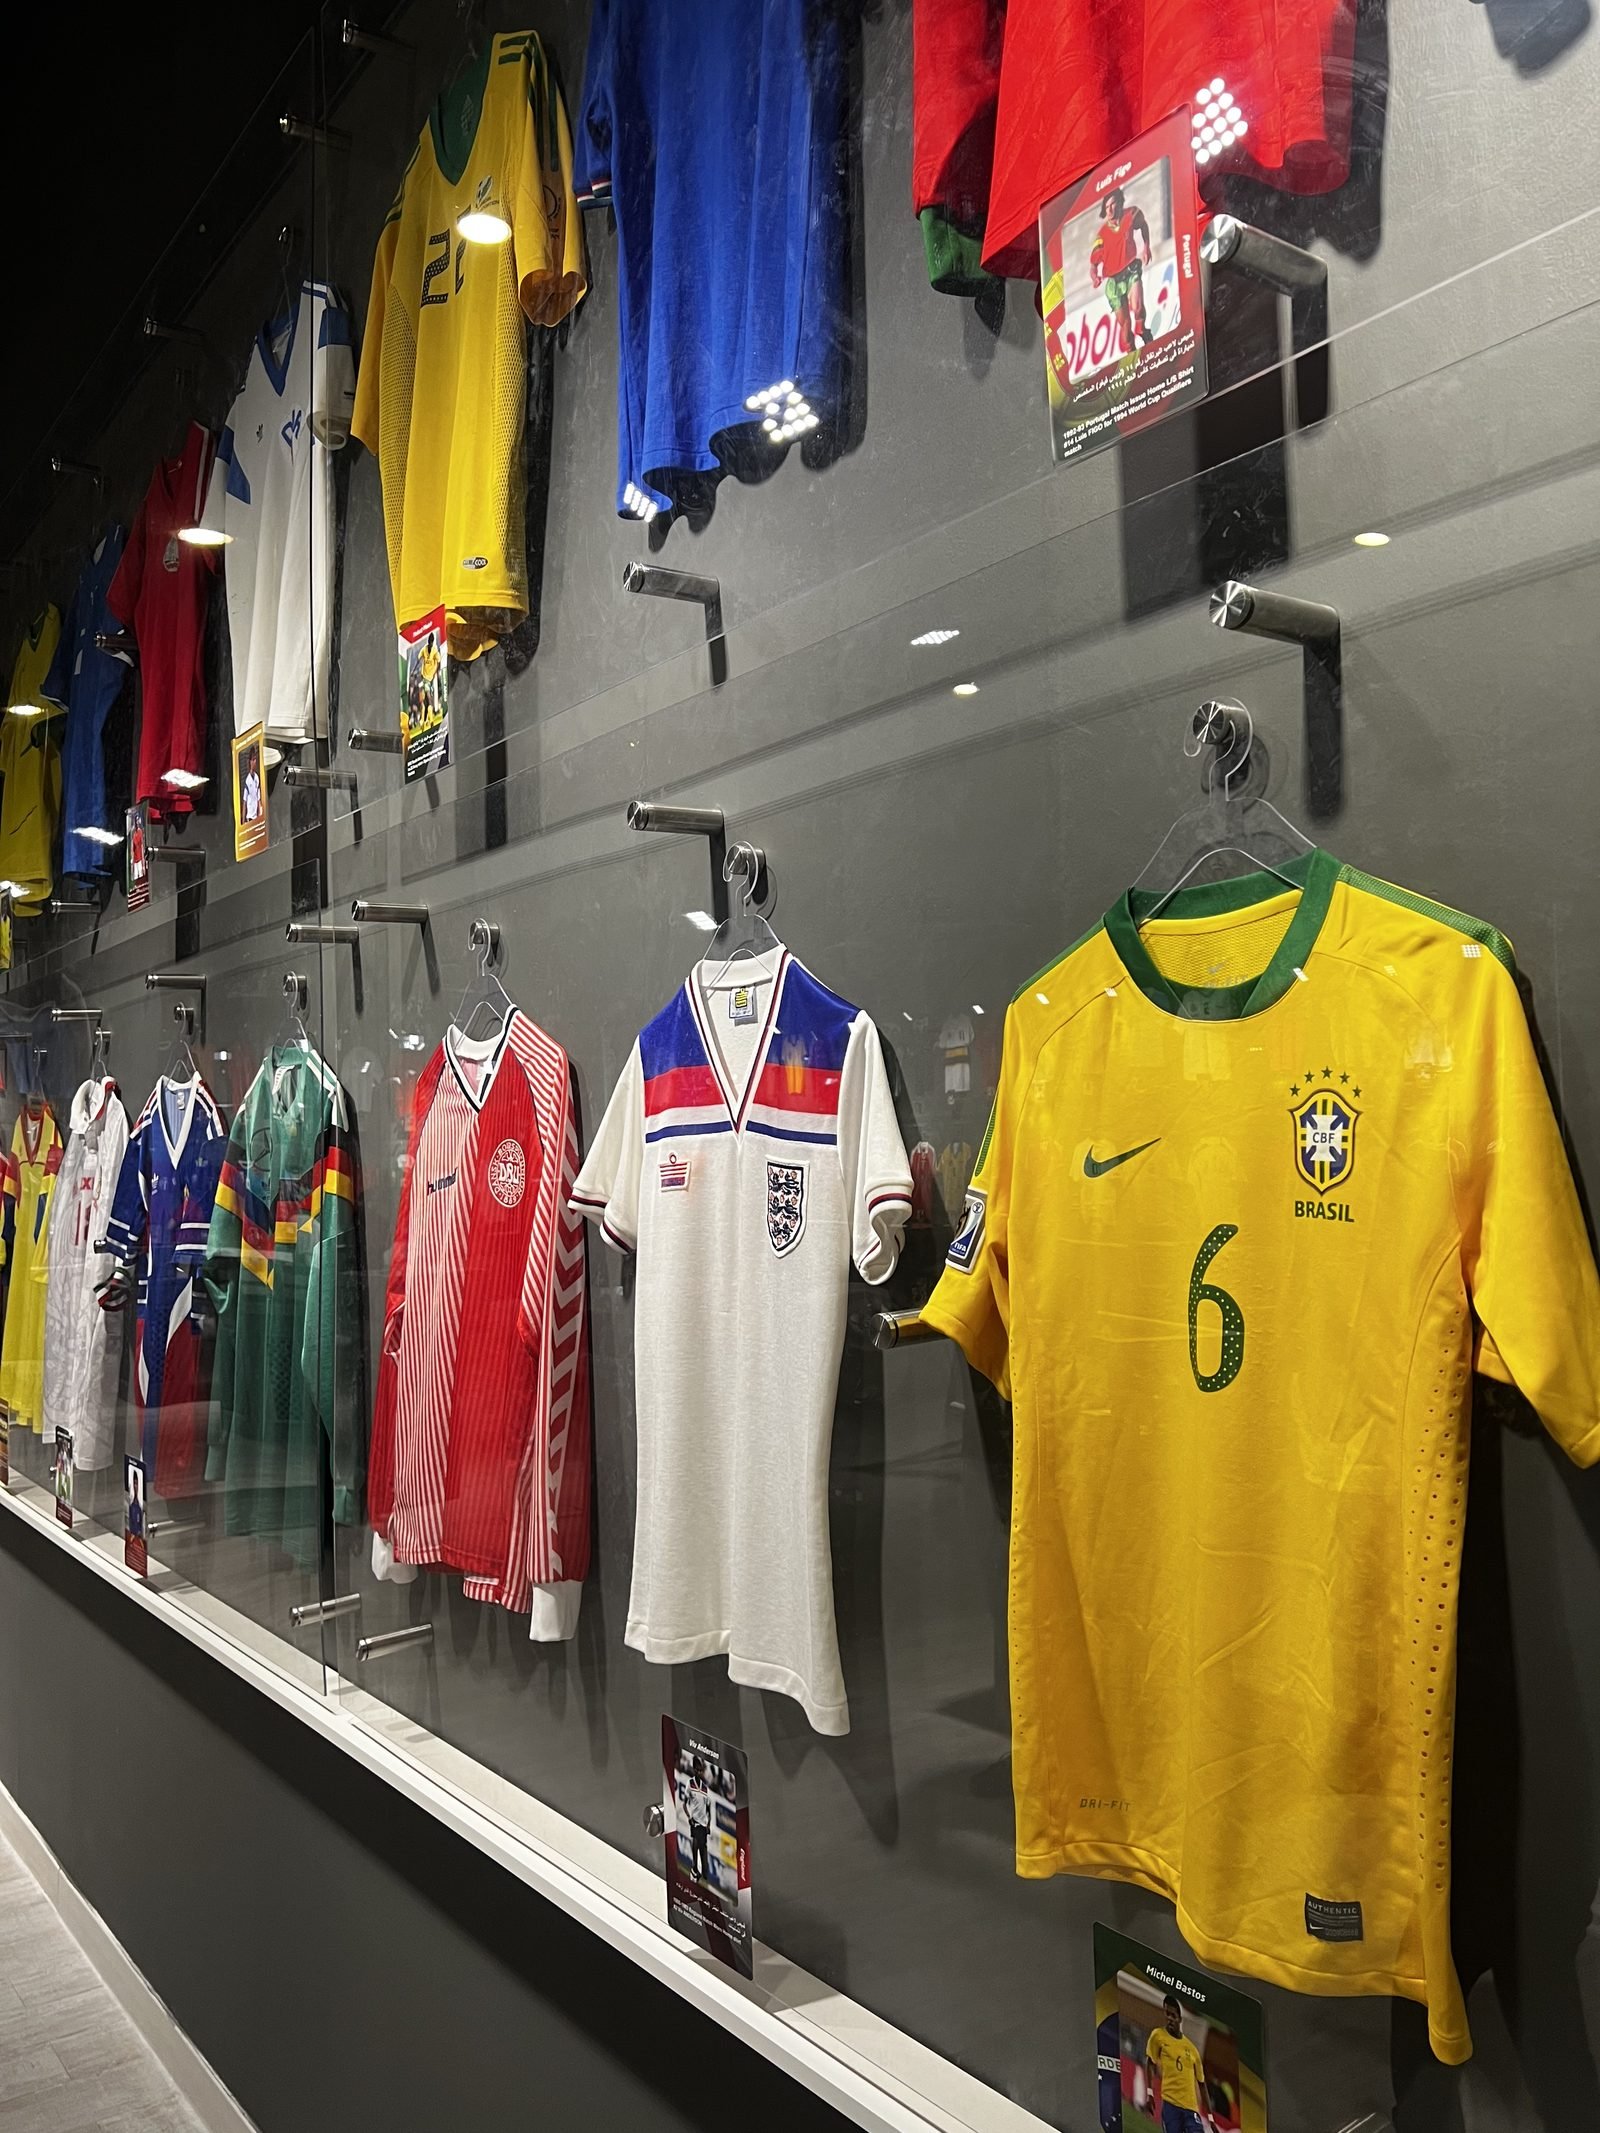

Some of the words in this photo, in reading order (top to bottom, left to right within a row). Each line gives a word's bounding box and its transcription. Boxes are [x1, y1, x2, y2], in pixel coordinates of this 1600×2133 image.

[1096, 175, 1112, 191] Luis
[1114, 162, 1131, 179] Figo
[1183, 234, 1193, 278] Portugal
[1085, 410, 1110, 427] Portugal
[1111, 401, 1129, 414] Match
[1130, 392, 1146, 405] Issue
[1147, 382, 1165, 395] Home
[1166, 375, 1177, 385] L/S
[1178, 366, 1194, 379] Shirt
[1075, 433, 1087, 443] Luis
[1088, 421, 1103, 436] FIGO
[1102, 419, 1112, 428] for
[1114, 411, 1127, 422] 1994
[1128, 401, 1146, 415] World
[1147, 395, 1160, 405] Cup
[1161, 378, 1191, 398] Qualifiers
[1064, 444, 1082, 457] match
[1312, 1131, 1335, 1144] CBF
[1294, 1200, 1355, 1223] BRASIL
[954, 1241, 967, 1252] FIFA
[1188, 1223, 1245, 1393] 6
[689, 1739, 697, 1748] Viv
[698, 1743, 719, 1759] Anderson
[1080, 1798, 1131, 1812] DRI-FIT
[1307, 1900, 1358, 1914] AUTHENTIC
[1146, 1965, 1174, 1985] Michel
[1176, 1980, 1205, 2002] Bastos
[1176, 2055, 1183, 2071] 6
